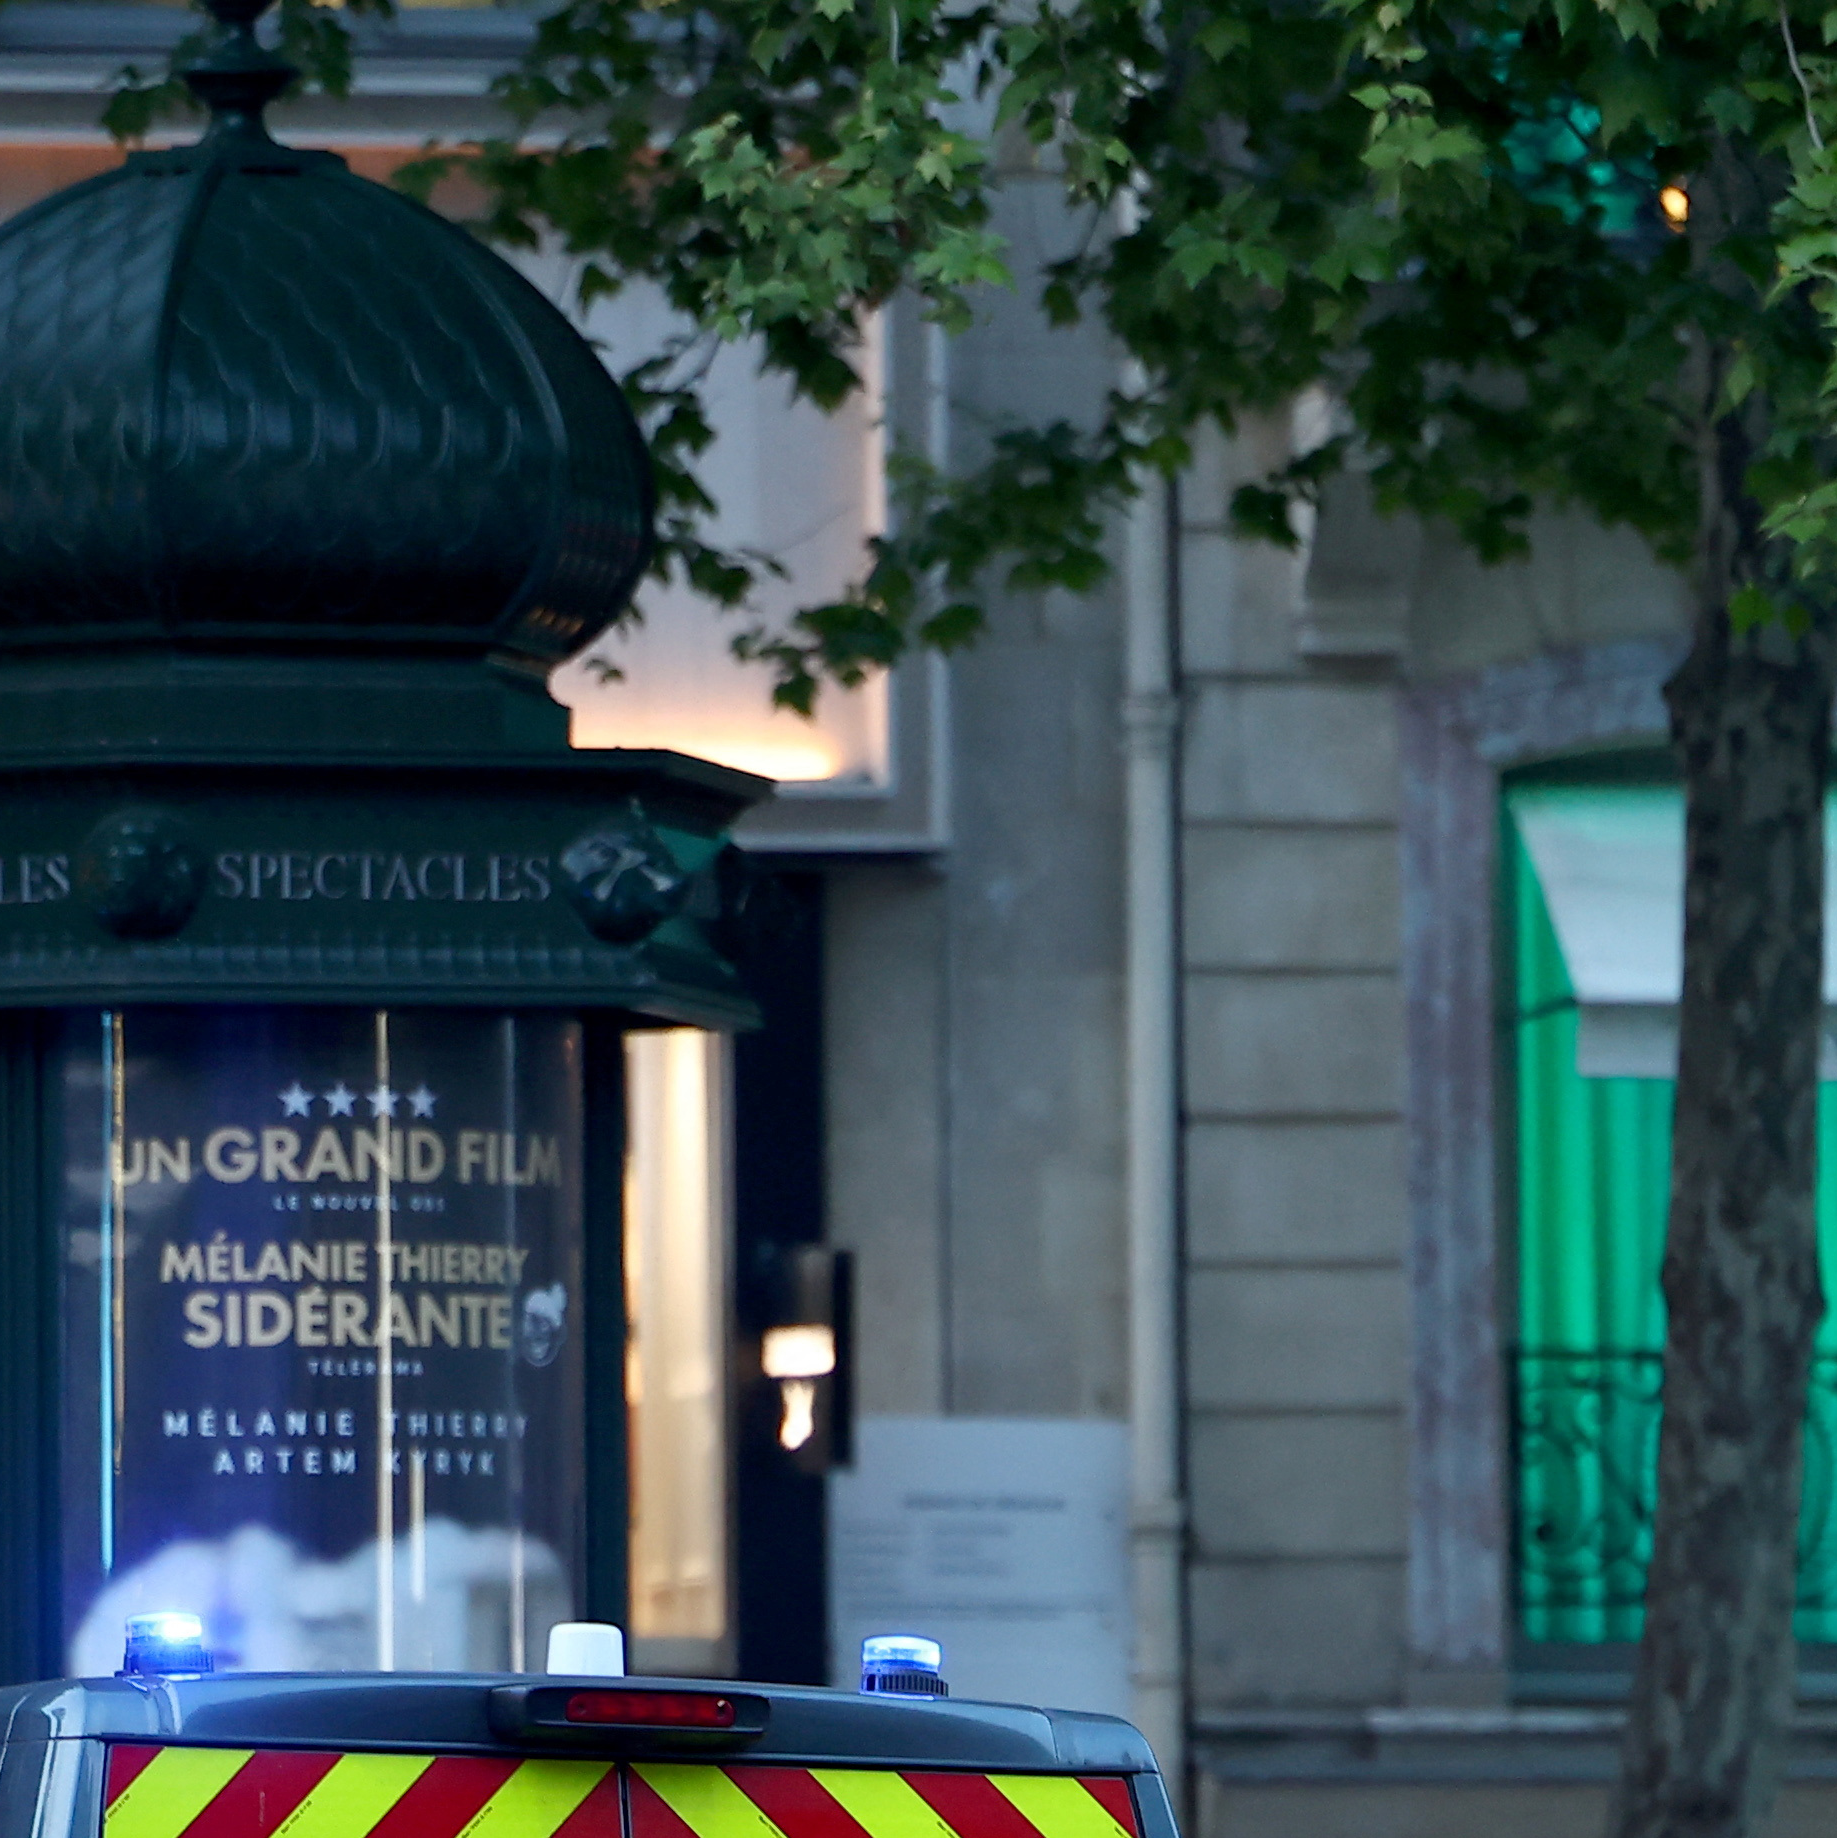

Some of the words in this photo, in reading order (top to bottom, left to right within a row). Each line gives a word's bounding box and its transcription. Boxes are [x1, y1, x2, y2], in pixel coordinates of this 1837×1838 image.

[213, 852, 552, 902] SPECTACLES
[111, 1138, 192, 1186] UN
[203, 1127, 446, 1184] GRAND
[460, 1131, 563, 1187] FILM
[311, 1194, 399, 1212] NOUVL
[160, 1231, 368, 1283] MÉLANIE
[376, 1244, 530, 1284] THIERRY
[184, 1283, 514, 1349] SIDÉRANTE
[308, 1357, 424, 1376] TÉLÉRMA
[162, 1407, 354, 1437] MÉLANIE
[213, 1446, 356, 1475] ARTEM
